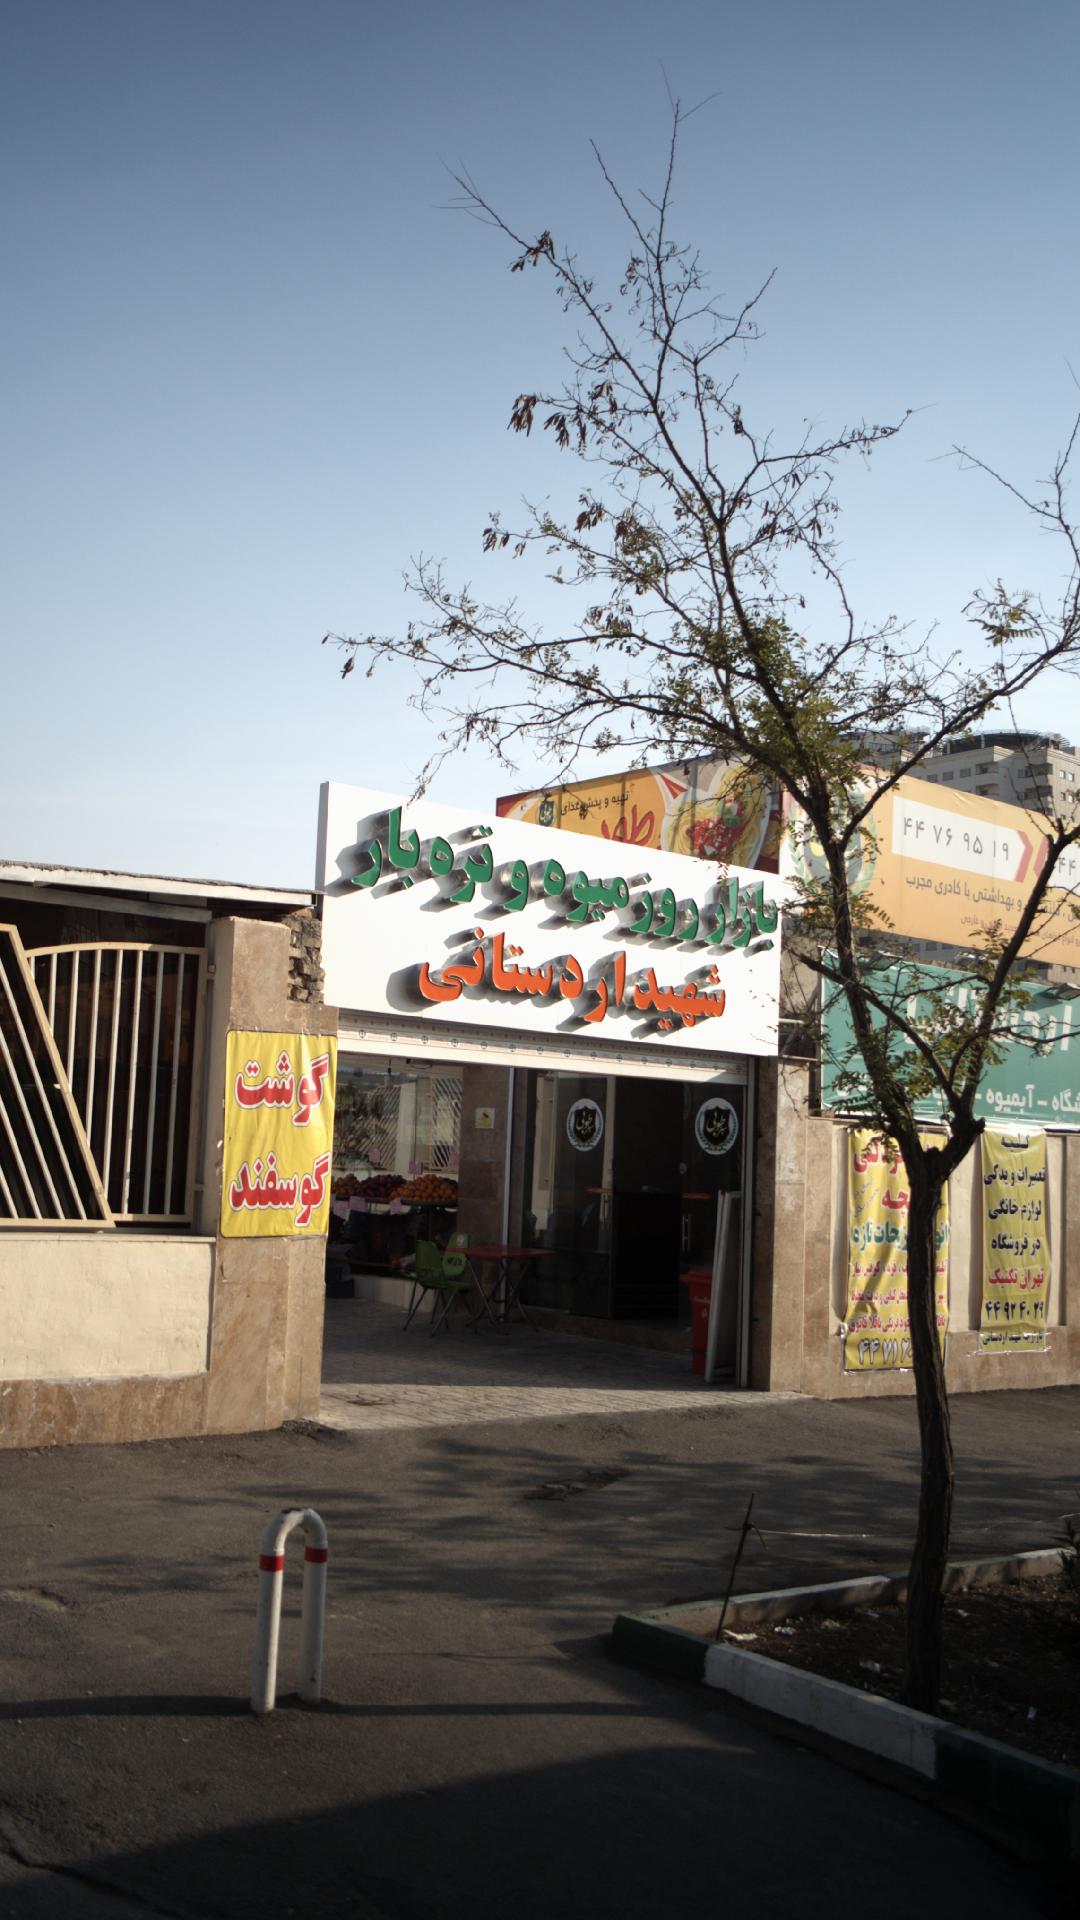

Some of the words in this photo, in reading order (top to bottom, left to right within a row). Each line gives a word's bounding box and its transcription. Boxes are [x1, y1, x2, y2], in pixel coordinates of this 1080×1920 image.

[351, 805, 420, 889] بار
[904, 817, 925, 838] ۴۴
[932, 824, 953, 846] ۷۶
[963, 832, 983, 854] ۹۵
[992, 839, 1009, 861] ۱۹
[427, 825, 494, 903] تره
[505, 859, 529, 911] و
[906, 874, 932, 890] مجرب
[542, 858, 630, 923] میوه
[629, 873, 699, 942] روز
[935, 879, 961, 895] کادری
[964, 881, 971, 897] با
[973, 887, 1015, 911] بهداشتی
[705, 876, 778, 948] بازار
[418, 926, 627, 1023] اردستانی
[634, 963, 726, 1030] شهید
[235, 1050, 330, 1126] گوشت
[986, 1084, 1035, 1114] آبمیوه
[230, 1152, 331, 1226] گوسفند
[1021, 1200, 1042, 1221] لوازم
[992, 1233, 1028, 1256] فروشگاه
[1030, 1238, 1041, 1256] در
[985, 1301, 1000, 1320] ۴۴
[858, 1338, 880, 1364] ۴۴
